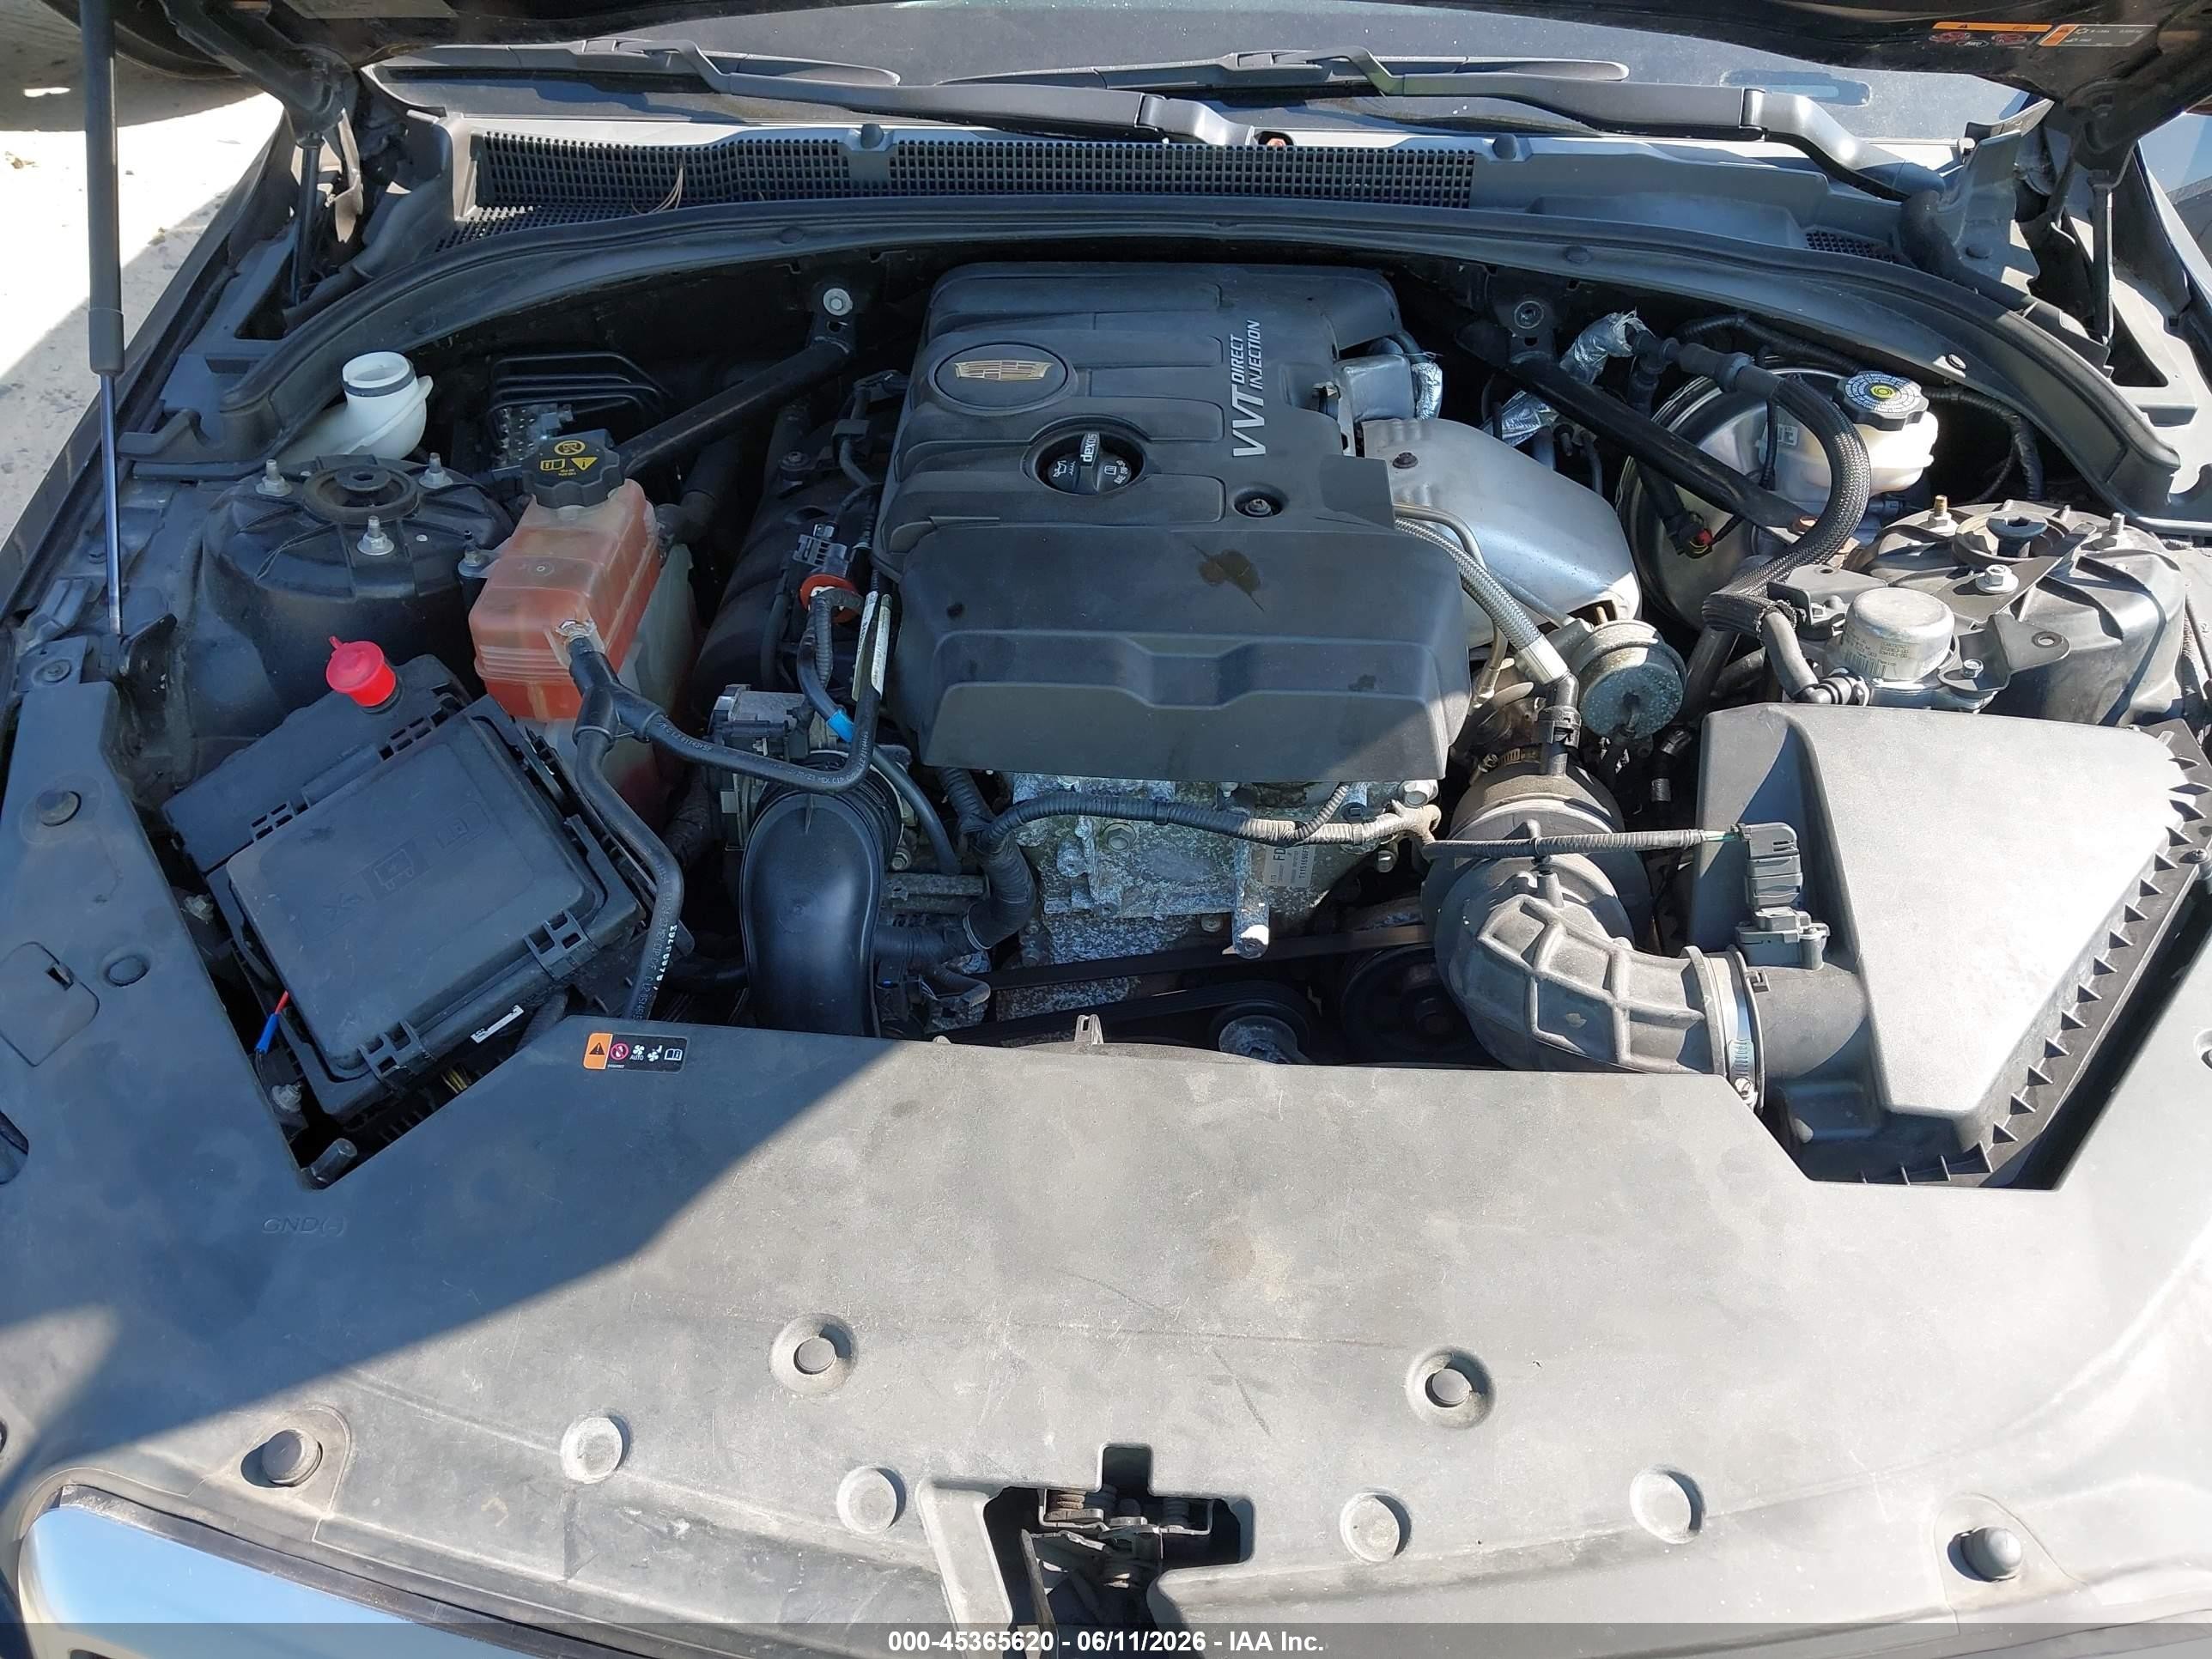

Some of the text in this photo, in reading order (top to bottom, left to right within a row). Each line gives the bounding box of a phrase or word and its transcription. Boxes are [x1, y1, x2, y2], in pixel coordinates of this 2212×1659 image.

[1231, 334, 1245, 384] DIRECT
[1247, 320, 1263, 390] INJECTION
[1232, 384, 1267, 457] VVT
[1080, 434, 1097, 462] dexos
[1273, 848, 1286, 861] FD
